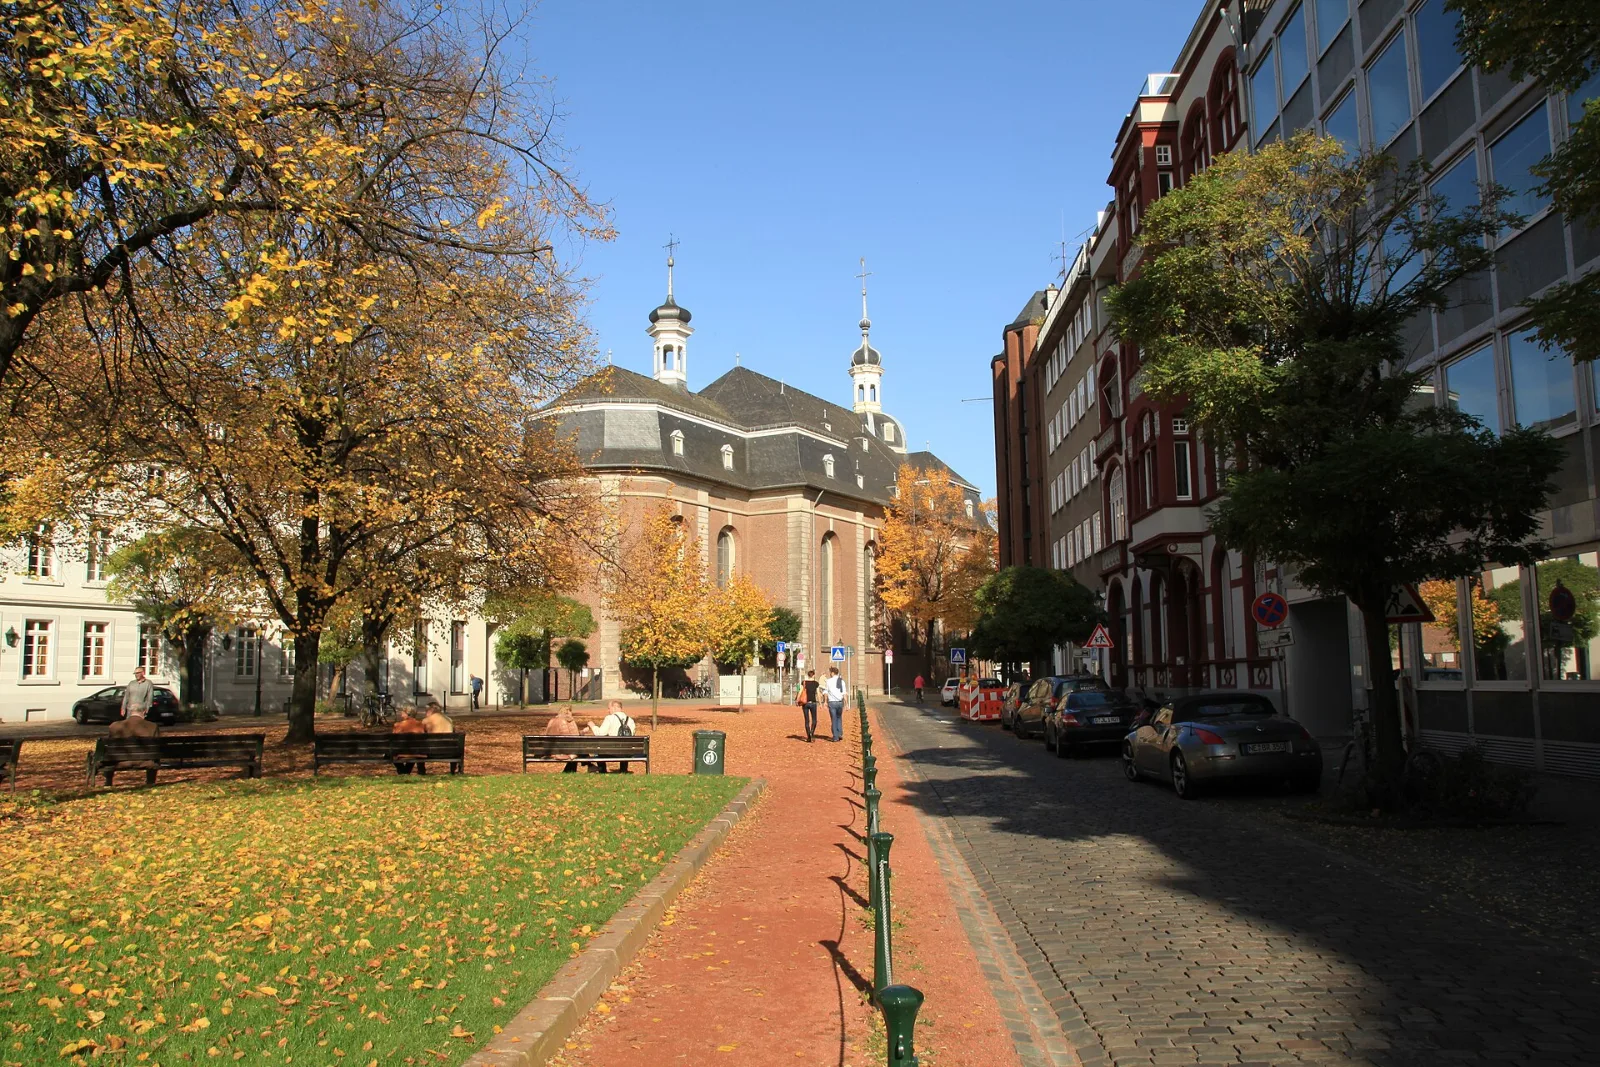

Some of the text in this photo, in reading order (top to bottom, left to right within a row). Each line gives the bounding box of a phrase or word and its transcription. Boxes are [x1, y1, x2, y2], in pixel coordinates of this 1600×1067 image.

[1248, 742, 1285, 752] NE BR 350
